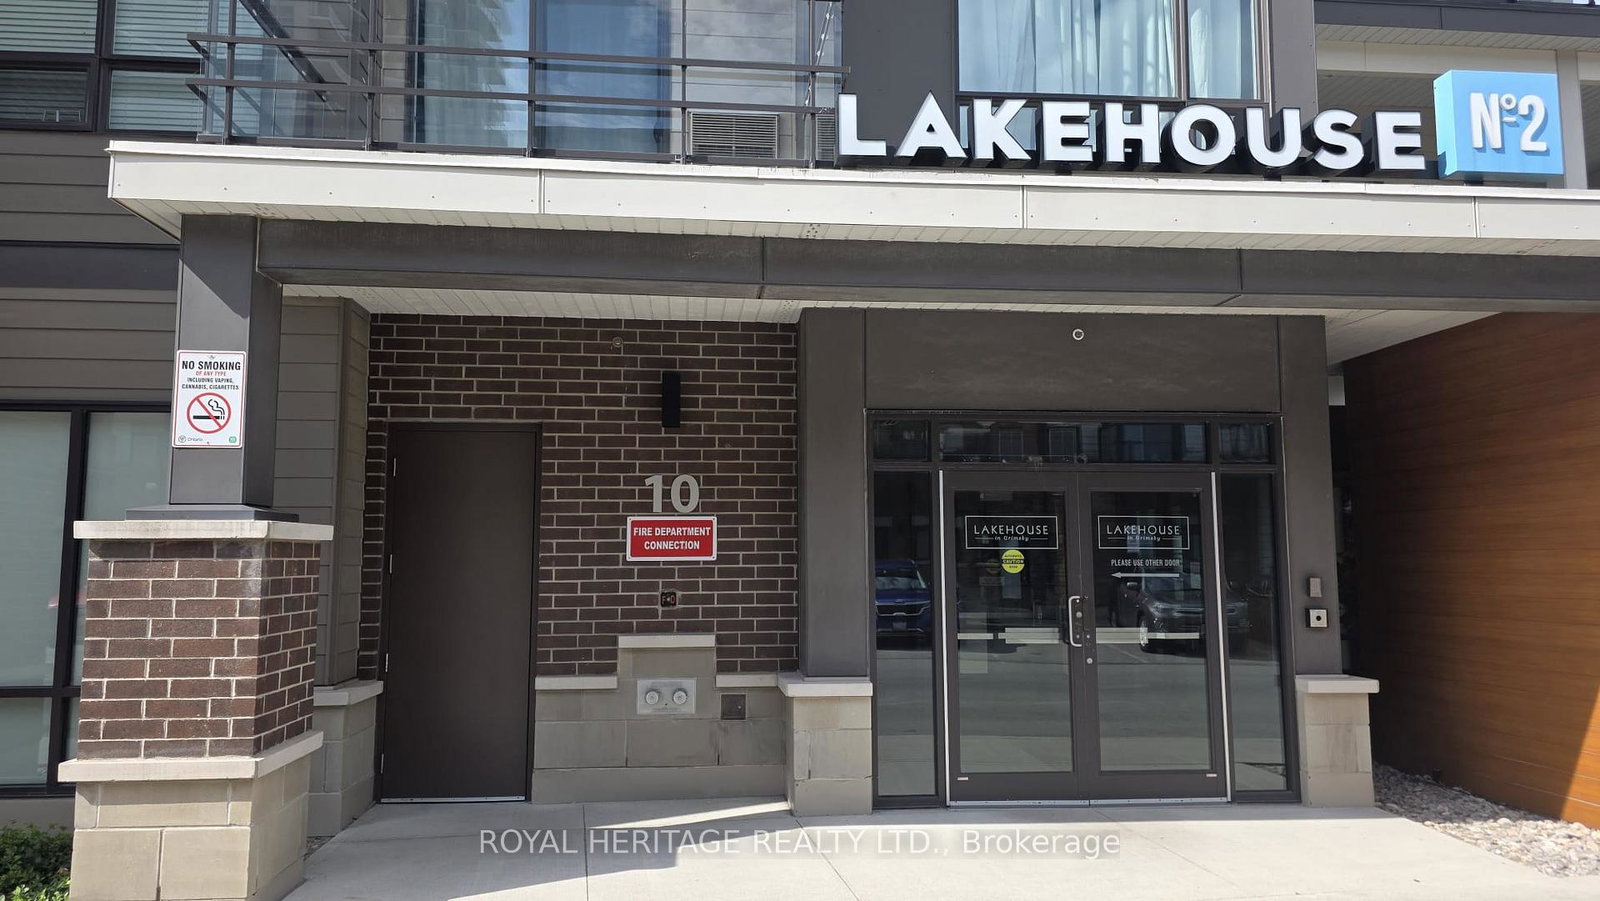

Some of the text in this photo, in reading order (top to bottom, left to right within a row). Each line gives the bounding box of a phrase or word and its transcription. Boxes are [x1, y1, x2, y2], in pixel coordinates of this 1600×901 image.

[838, 91, 1427, 170] LAKEHOUSE
[182, 360, 241, 371] NO SMOKING
[644, 474, 699, 513] 10
[633, 527, 711, 536] FIRE DEPARTMENT
[973, 525, 1049, 535] LAKEHOUSE
[1106, 525, 1180, 535] LAKEHOUSE
[644, 541, 700, 550] CONNECTION
[1133, 559, 1144, 567] USE
[1145, 559, 1163, 567] OTHER
[1164, 559, 1180, 567] DOOR
